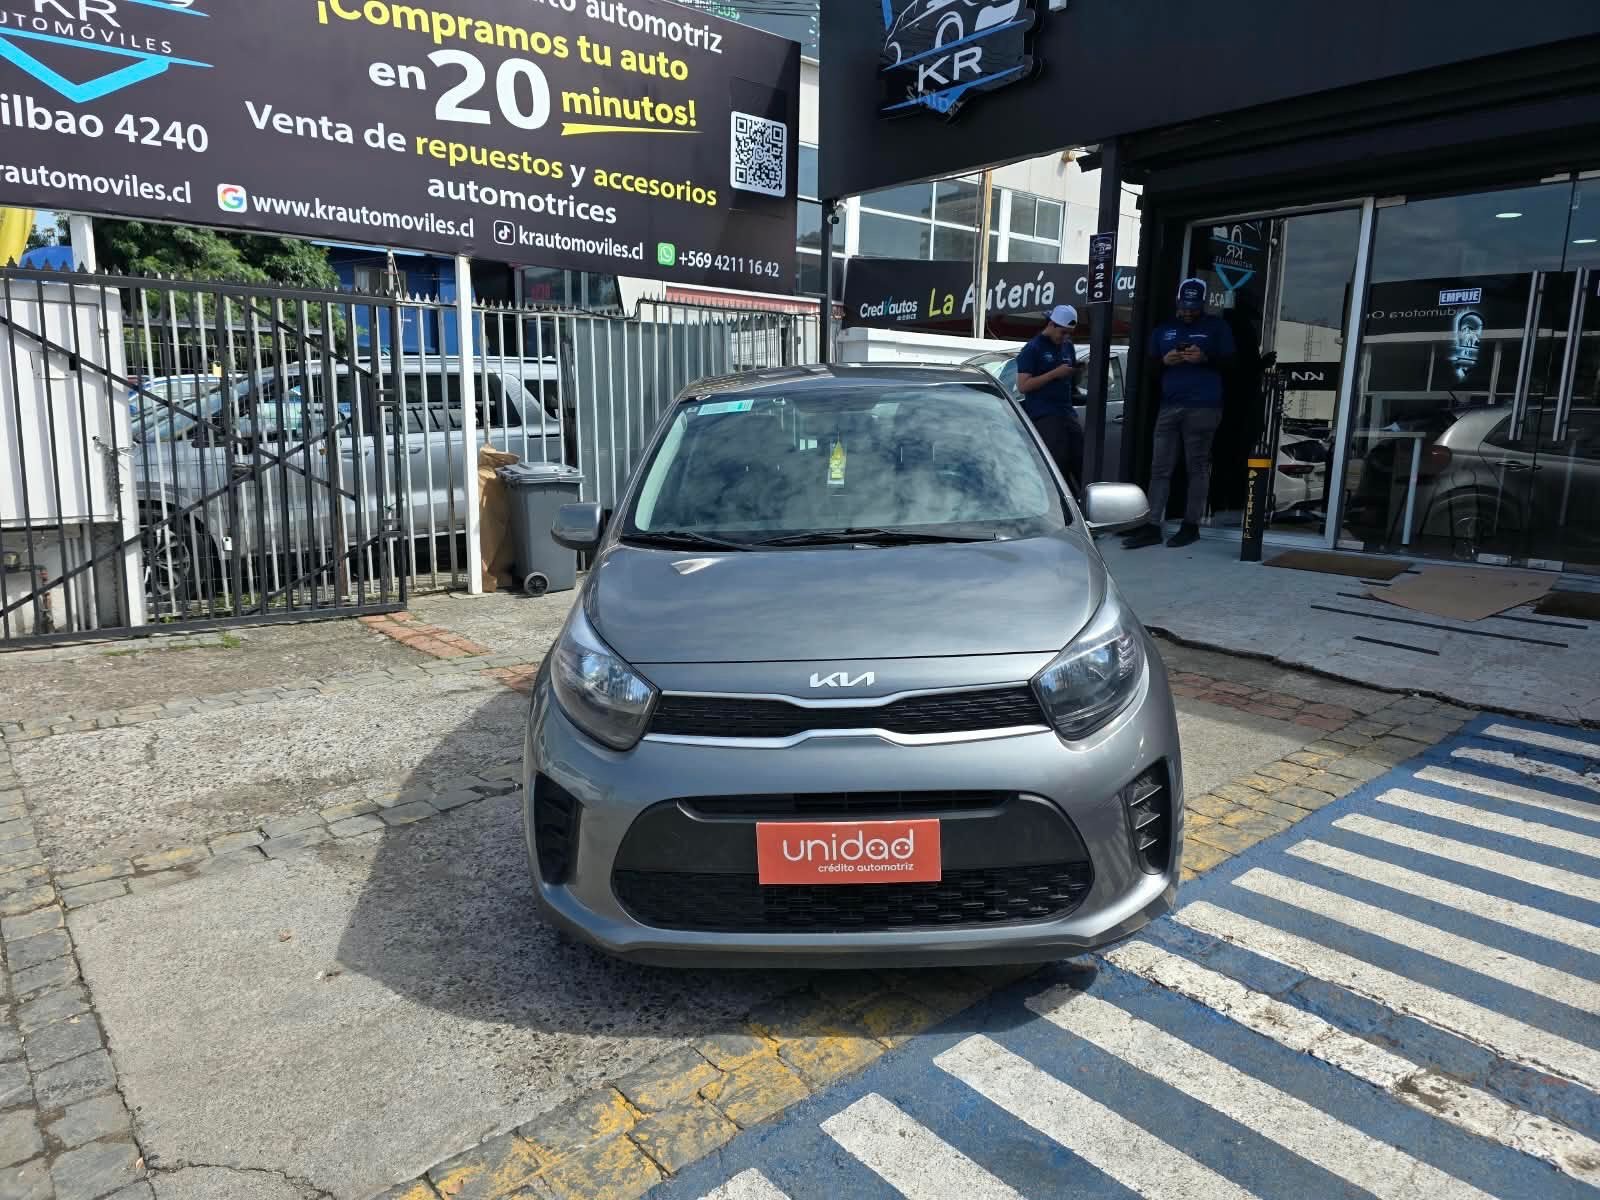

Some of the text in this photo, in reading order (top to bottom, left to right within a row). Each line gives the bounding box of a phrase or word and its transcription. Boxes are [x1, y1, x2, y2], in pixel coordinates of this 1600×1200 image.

[586, 0, 723, 54] automotriz
[577, 36, 612, 67] tu
[620, 49, 688, 81] auto
[918, 46, 983, 92] KR
[368, 49, 697, 130] en 20 minutos!
[114, 113, 209, 153] 4240
[245, 100, 717, 207] Venta de repuestos y accesorios
[252, 195, 475, 237] www.krautomoviles.cl
[427, 178, 617, 224] automotrices
[519, 225, 644, 260] krautomoviles.cl
[679, 251, 780, 278] +569 4211 16 42
[1094, 262, 1105, 298] 4240
[928, 287, 955, 318] La
[1441, 289, 1480, 303] EMPUJE
[809, 671, 875, 688] KIA
[783, 829, 914, 861] unidad
[818, 862, 914, 873] crédito automotriz
